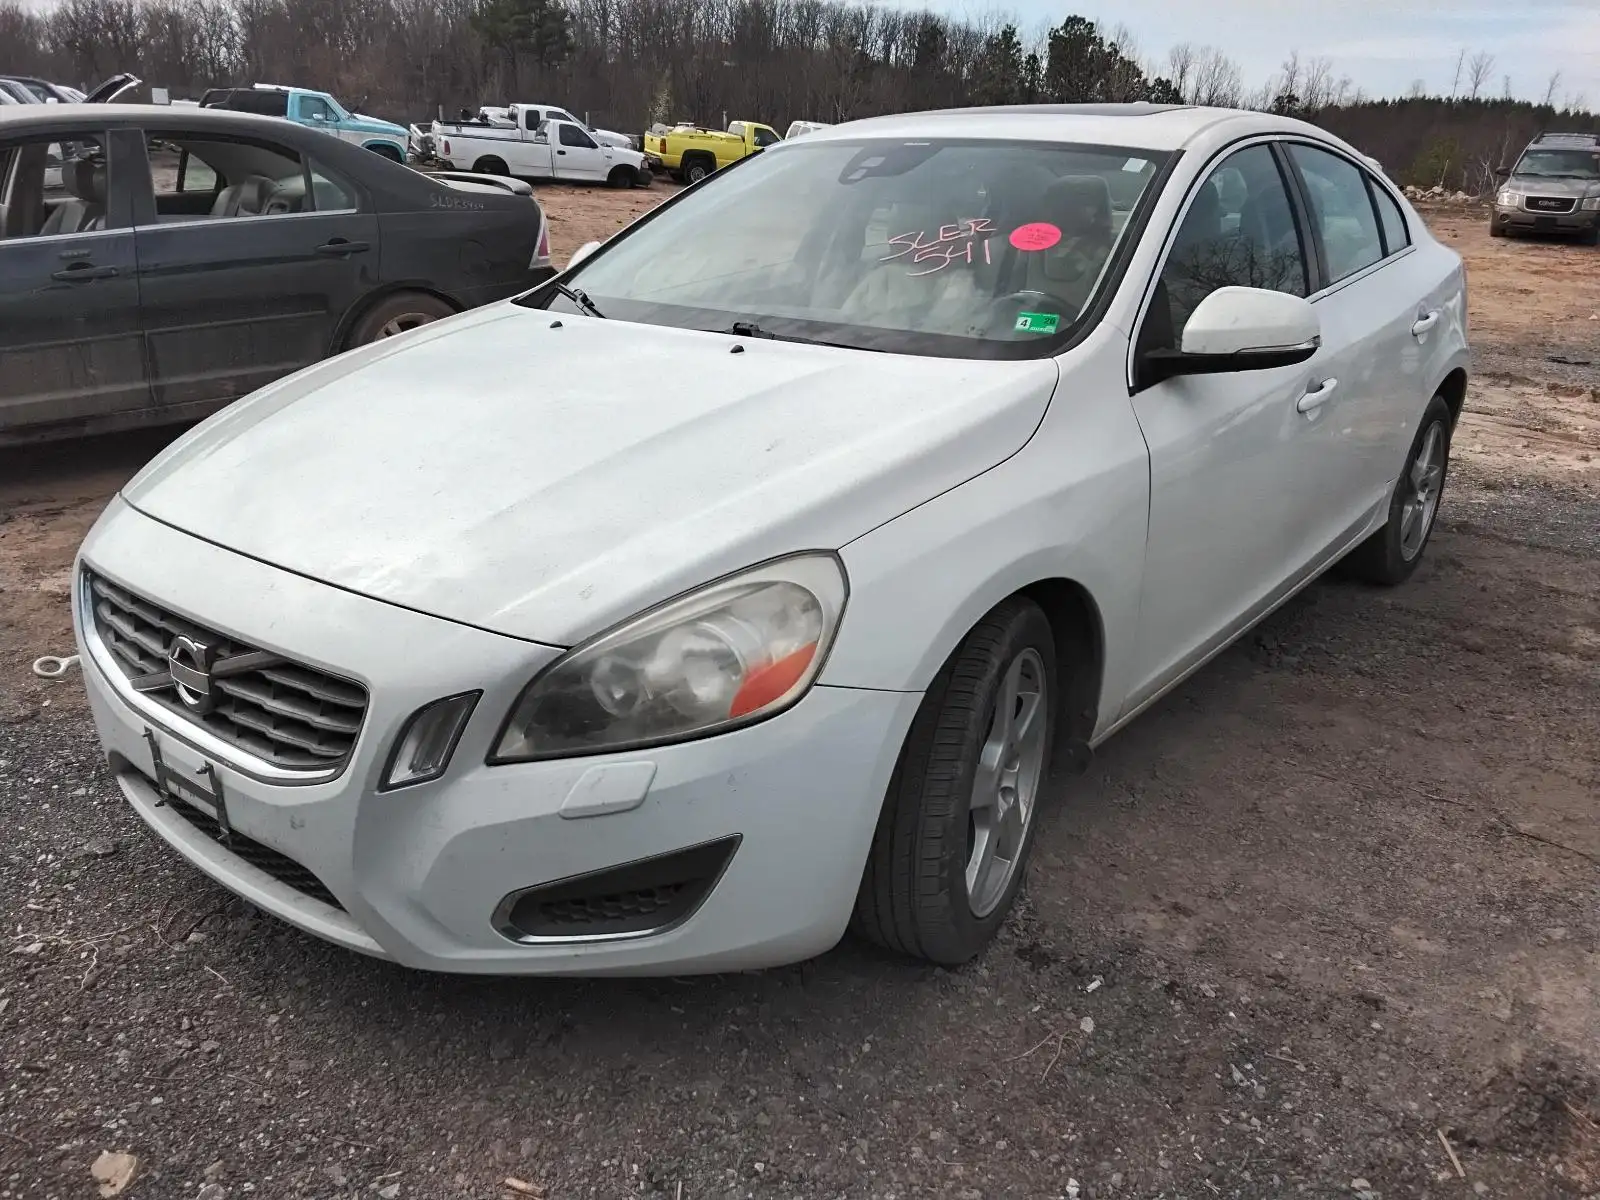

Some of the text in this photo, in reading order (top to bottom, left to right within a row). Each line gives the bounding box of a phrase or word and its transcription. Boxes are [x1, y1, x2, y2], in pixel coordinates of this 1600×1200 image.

[1538, 200, 1561, 208] GMC
[906, 239, 990, 276] 541
[1020, 319, 1028, 327] 4
